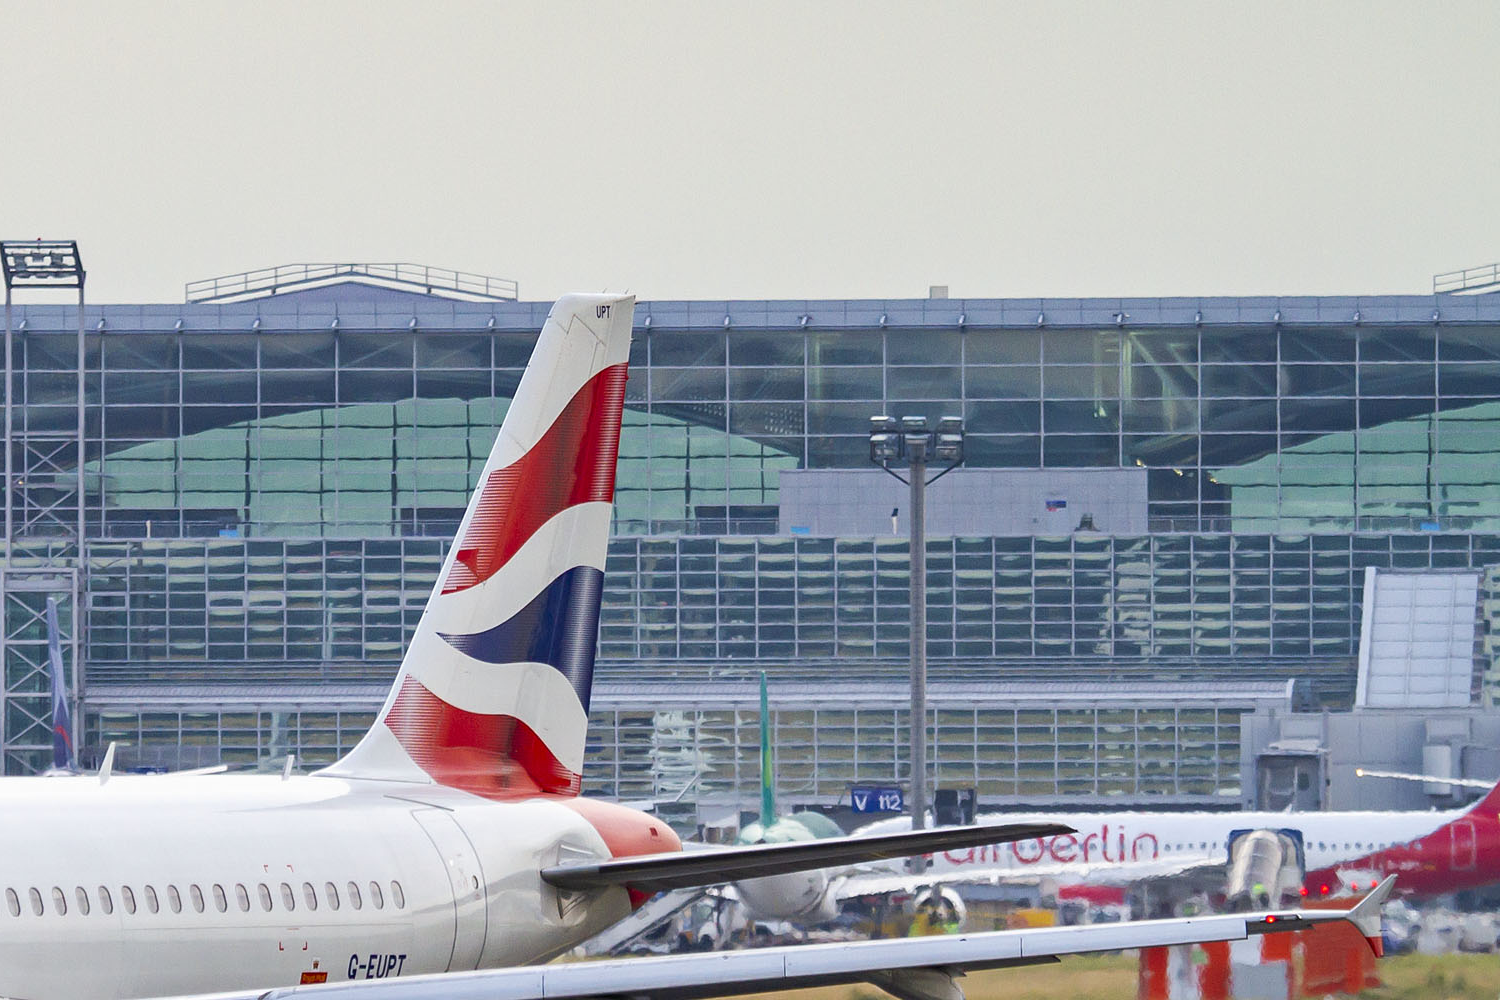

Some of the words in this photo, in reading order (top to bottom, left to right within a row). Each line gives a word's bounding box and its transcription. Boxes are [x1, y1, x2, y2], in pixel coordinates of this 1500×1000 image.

[596, 305, 610, 319] UPT
[854, 795, 868, 811] V
[878, 794, 902, 811] 112
[347, 954, 407, 980] G-EUPT
